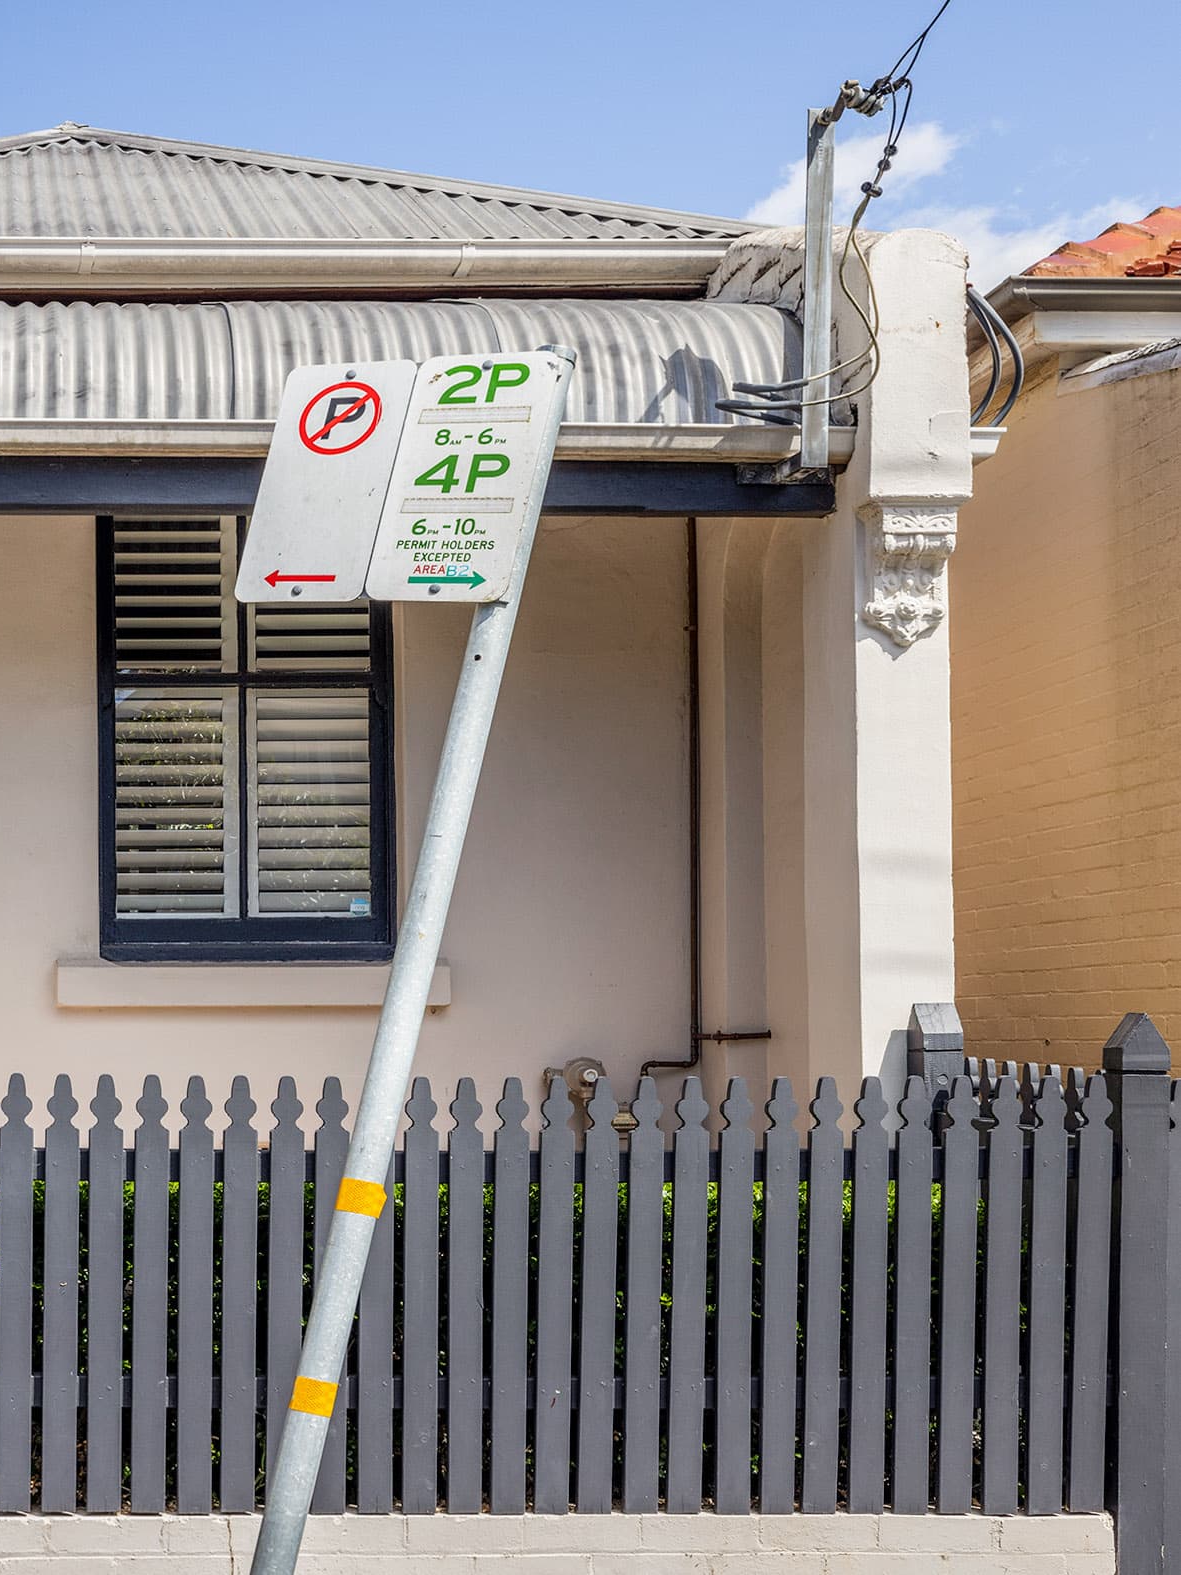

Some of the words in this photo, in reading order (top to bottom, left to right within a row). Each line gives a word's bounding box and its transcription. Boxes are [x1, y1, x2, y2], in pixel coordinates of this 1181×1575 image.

[438, 363, 530, 404] 2P
[414, 453, 511, 493] 4P
[396, 540, 437, 550] PERMIT
[441, 540, 495, 550] HOLDERS
[413, 552, 471, 562] EXCEPTED
[413, 565, 445, 574] AREA
